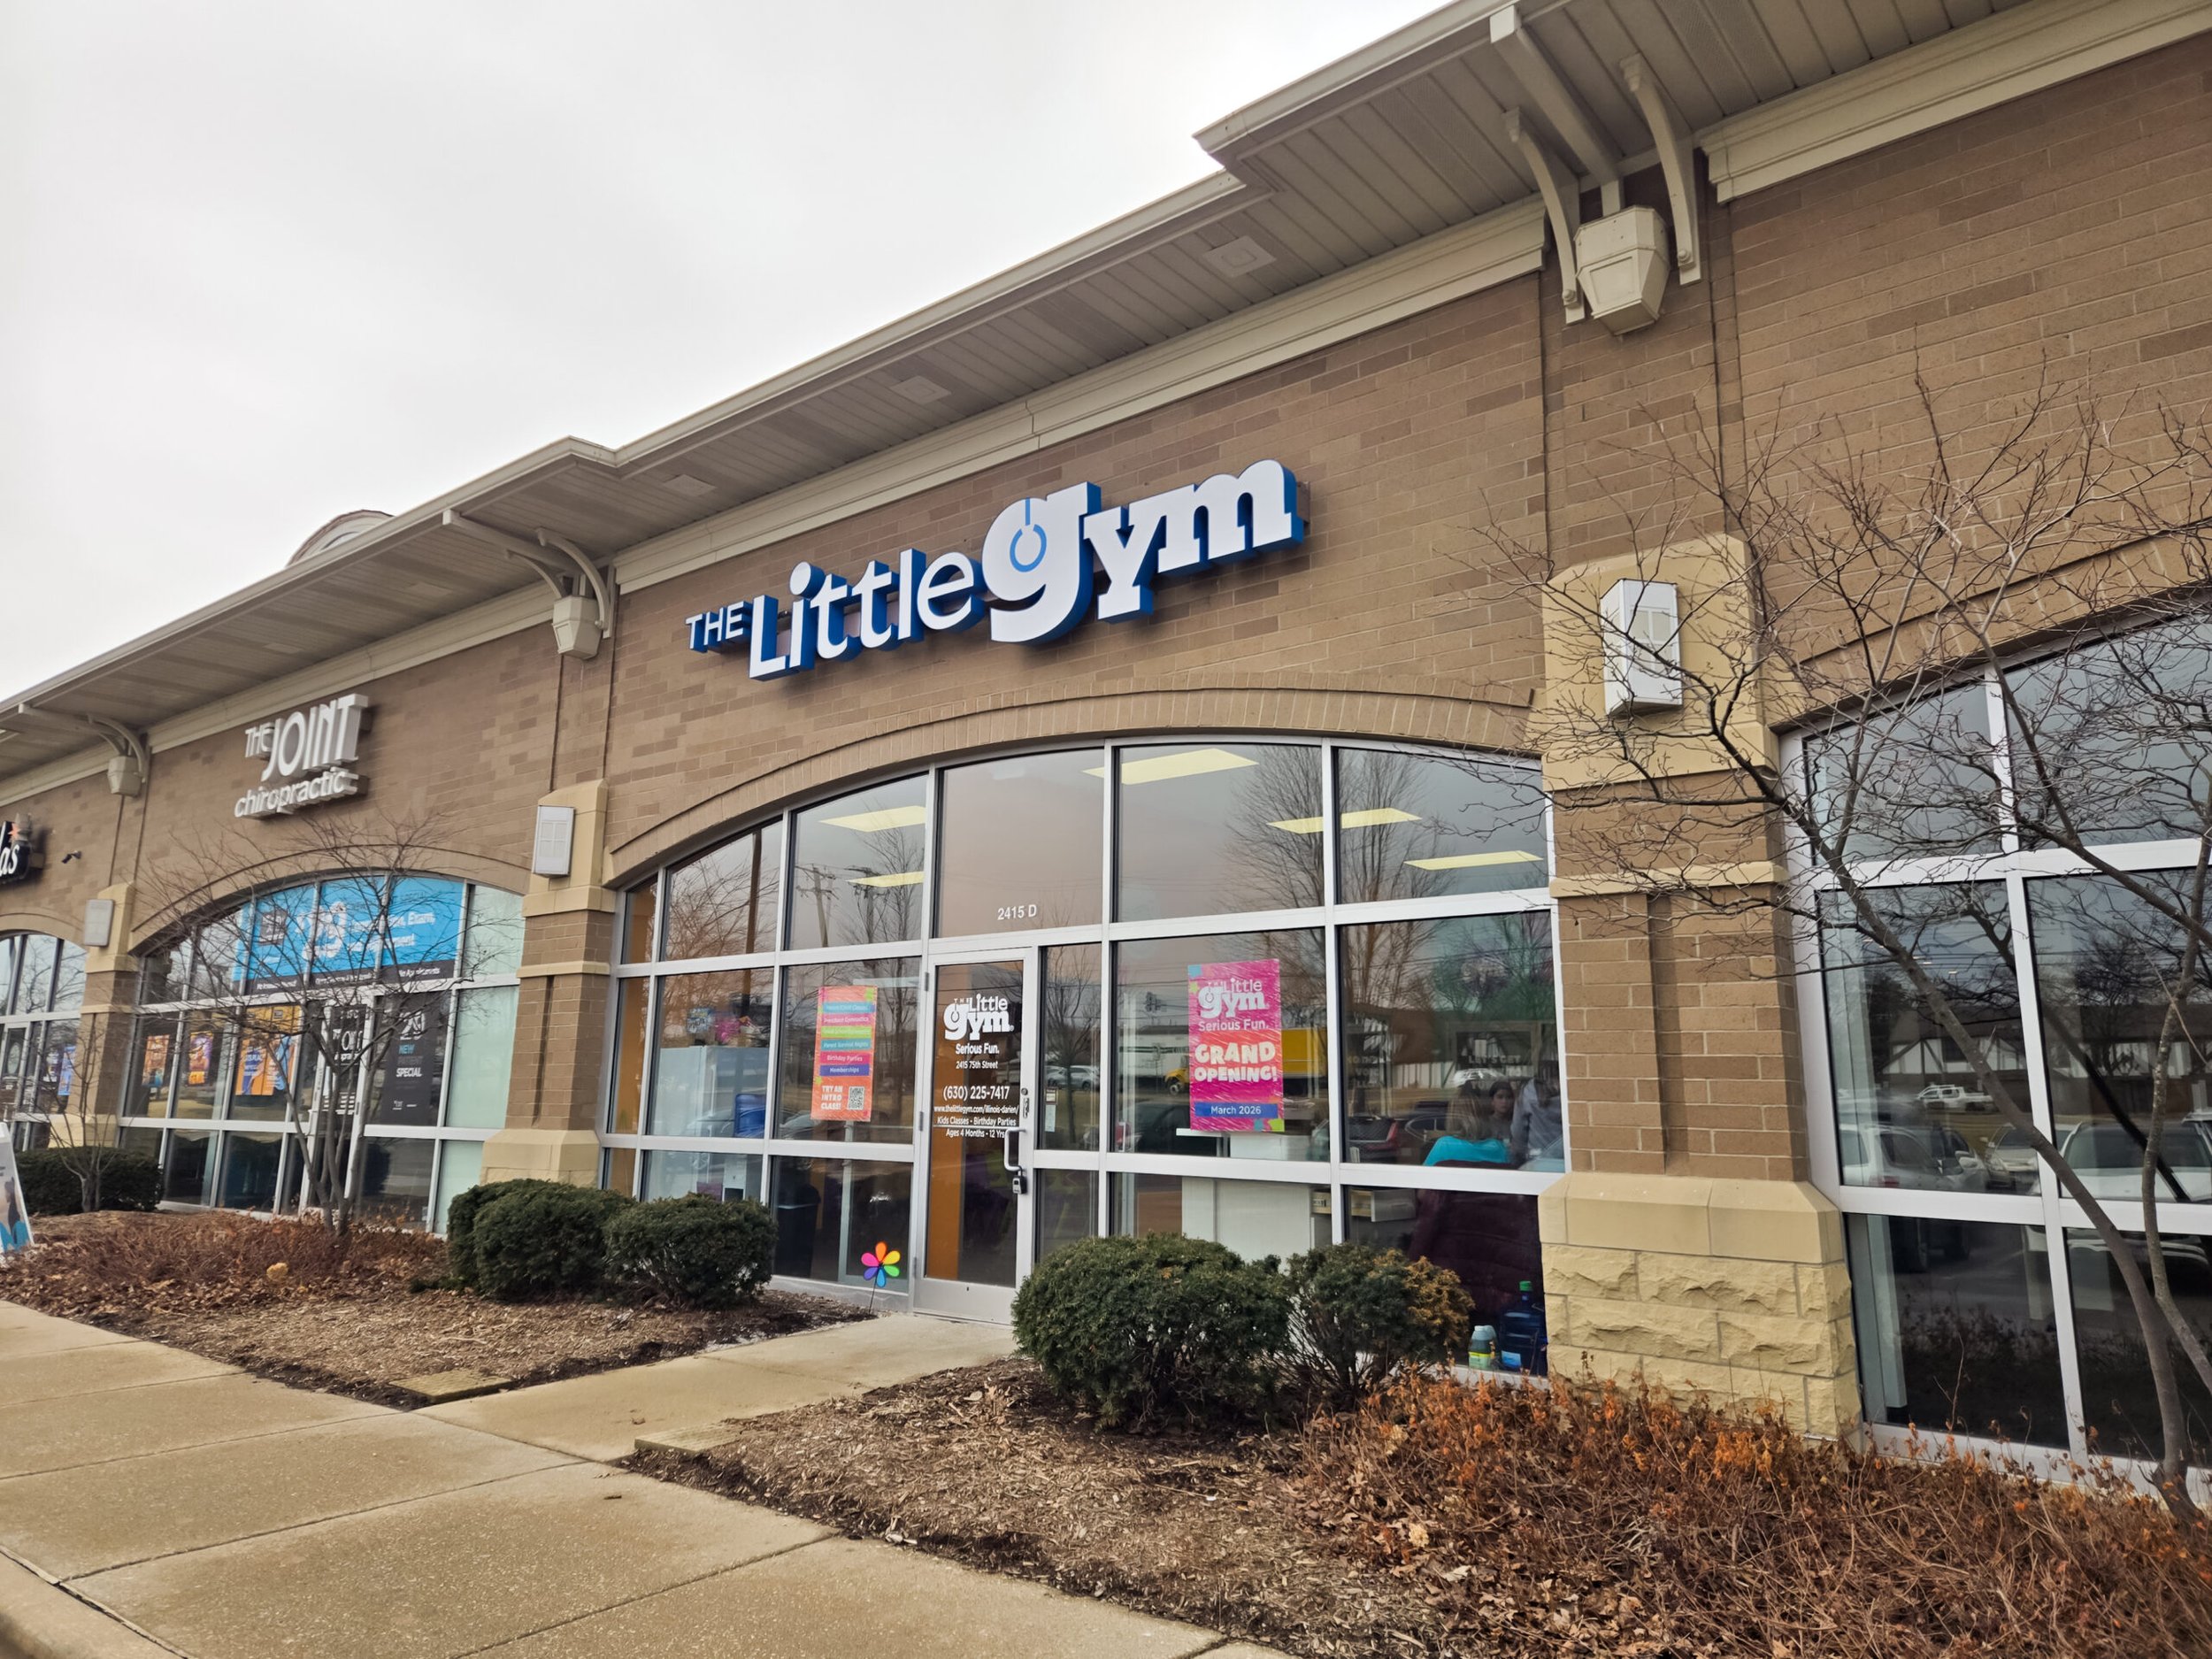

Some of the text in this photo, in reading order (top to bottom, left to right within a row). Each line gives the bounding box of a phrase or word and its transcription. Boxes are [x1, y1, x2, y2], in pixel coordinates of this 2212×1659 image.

[685, 459, 1302, 681] THE Little gym
[245, 694, 361, 782] THE JOINT
[234, 767, 353, 818] chiropractic
[997, 904, 1037, 920] 2415 D
[1223, 978, 1262, 993] Little
[970, 993, 1008, 1011] Little
[1198, 986, 1267, 1018] gym
[943, 1002, 1010, 1041] gym
[1198, 1019, 1269, 1032] Serious Fun.
[956, 1043, 1000, 1055] Serious Fun.
[1195, 1041, 1276, 1065] GRAND
[396, 1067, 423, 1077] SPECIAL
[981, 1061, 998, 1070] Street
[1194, 1065, 1278, 1083] OPENING!
[943, 1086, 1010, 1101] (630) 225-7417
[1210, 1106, 1262, 1115] March 2026
[973, 1117, 996, 1127] Birthday
[997, 1118, 1017, 1126] Parties
[946, 1129, 959, 1138] Ages
[964, 1129, 985, 1138] Months
